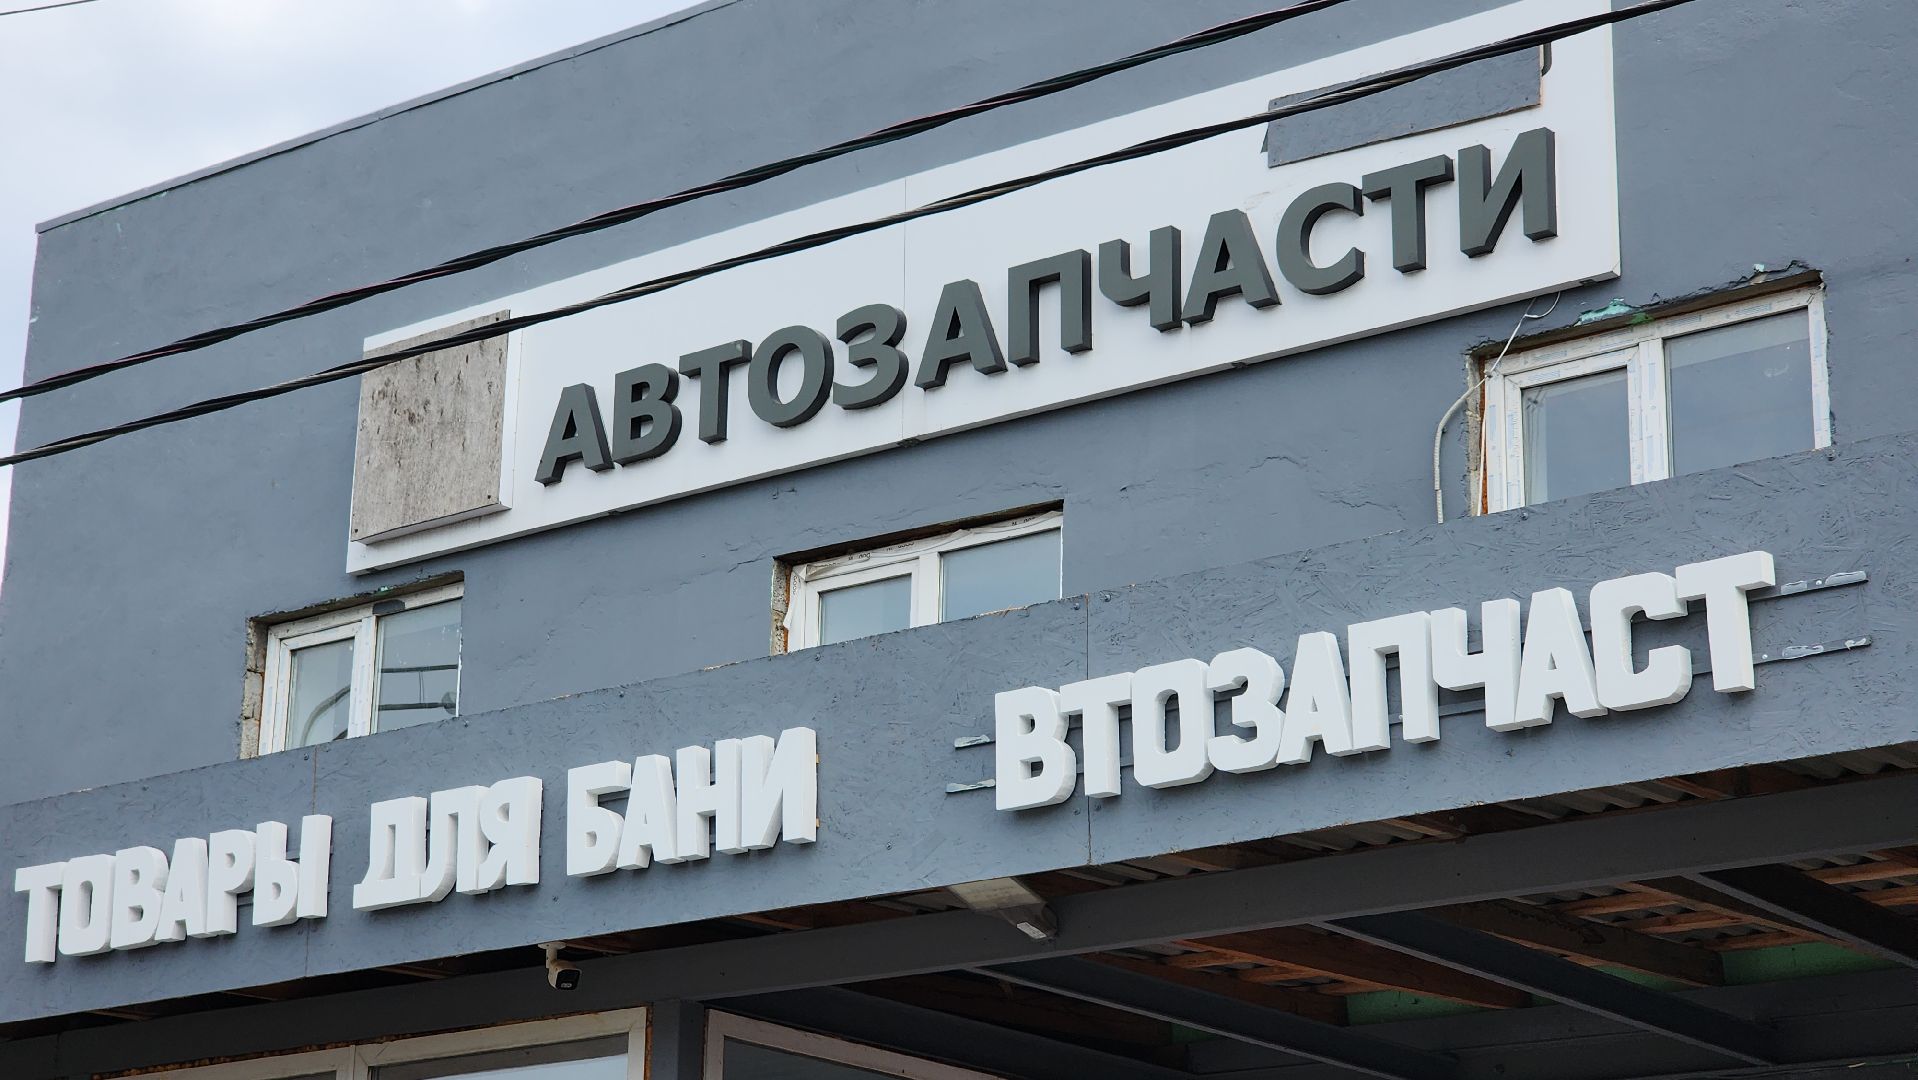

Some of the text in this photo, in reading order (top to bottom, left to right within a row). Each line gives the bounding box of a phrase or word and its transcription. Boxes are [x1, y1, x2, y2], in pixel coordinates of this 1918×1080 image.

[534, 126, 1558, 487] АВТОЗАПЧАСТИ
[995, 550, 1776, 812] ВТОЗАПЧАСТ
[15, 726, 817, 963] ТОВАРЫ ДЛЯ БАНИ
